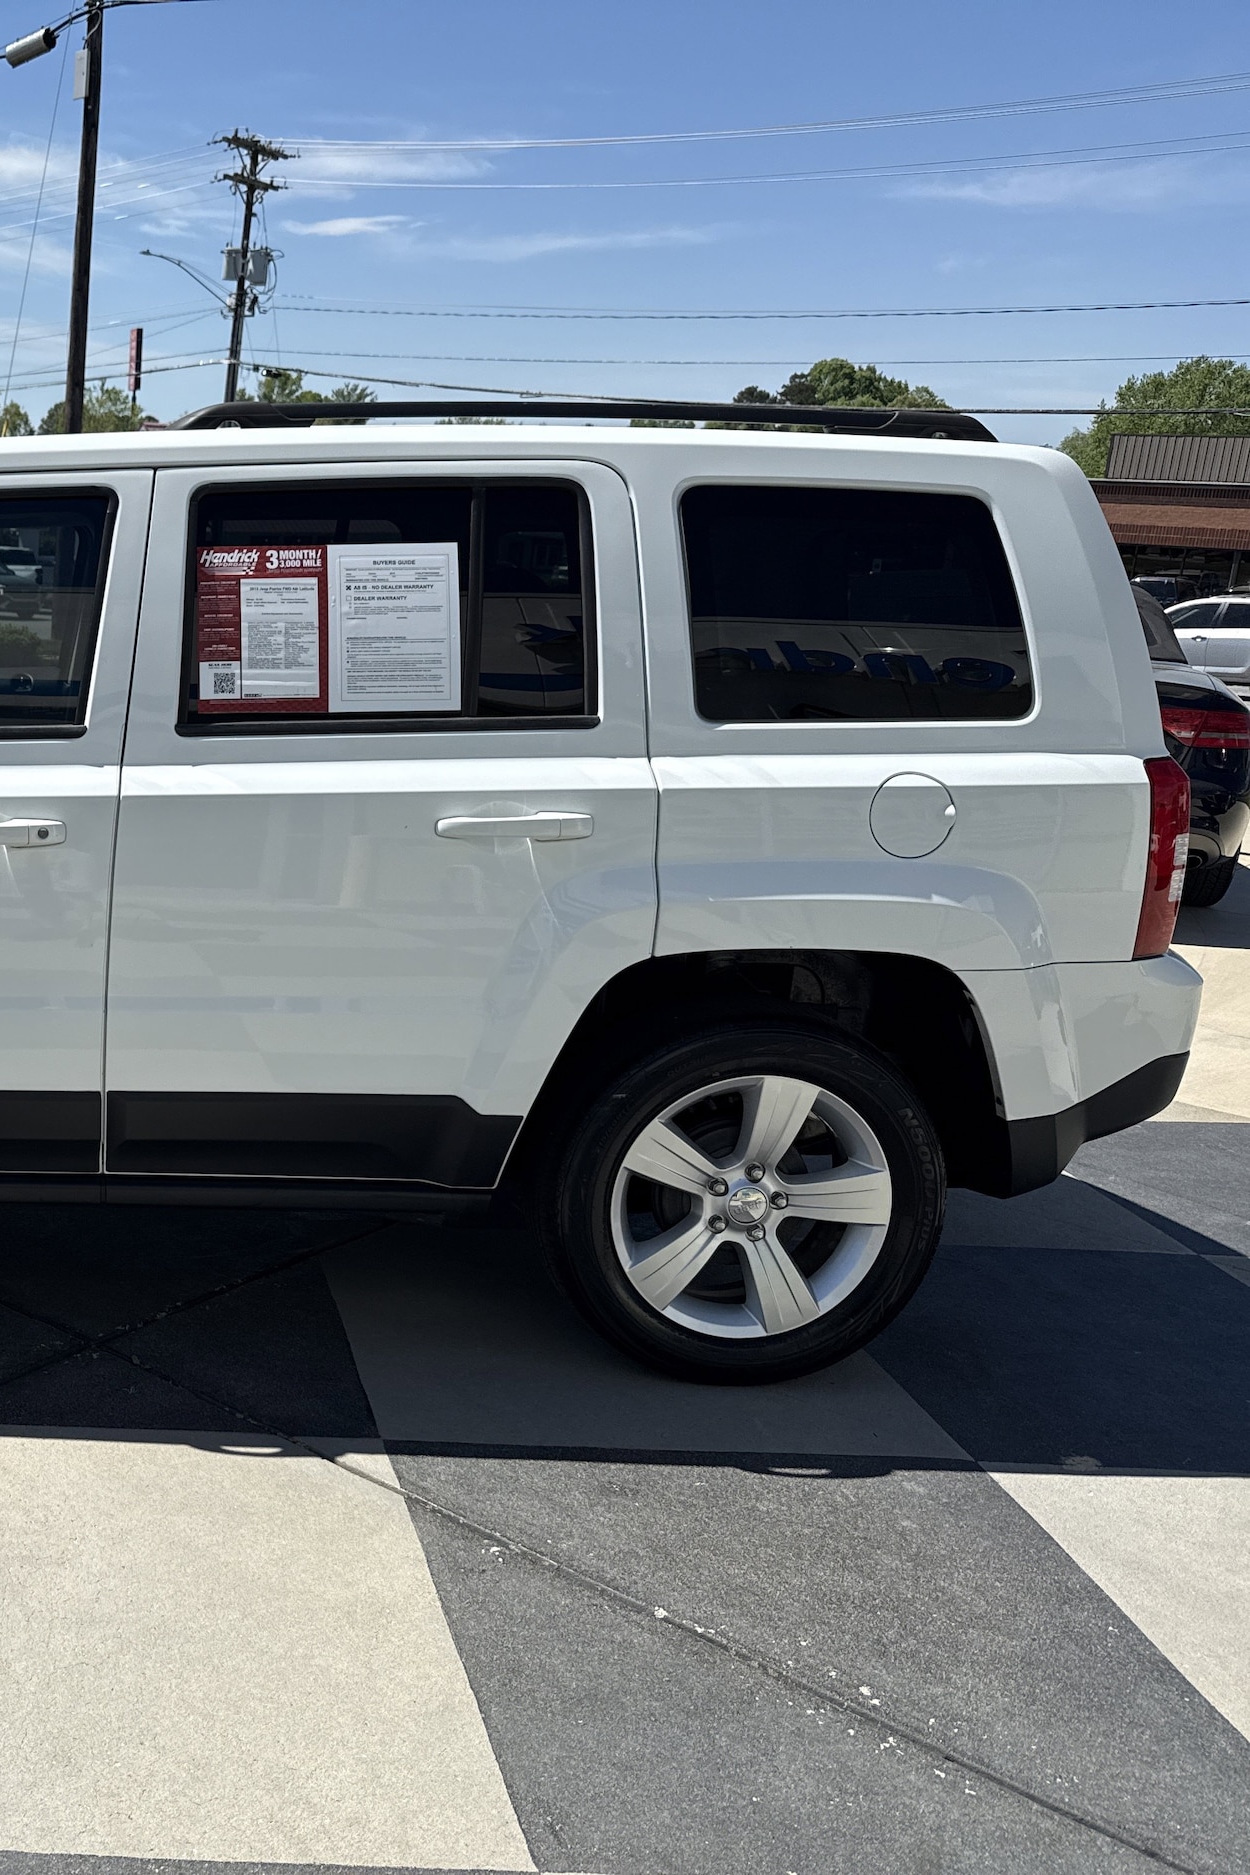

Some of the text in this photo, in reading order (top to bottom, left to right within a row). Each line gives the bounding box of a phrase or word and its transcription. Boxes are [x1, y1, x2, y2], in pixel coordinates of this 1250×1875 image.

[200, 549, 260, 567] Hendrick
[265, 549, 279, 569] 3
[279, 559, 322, 568] 3,000 MILE
